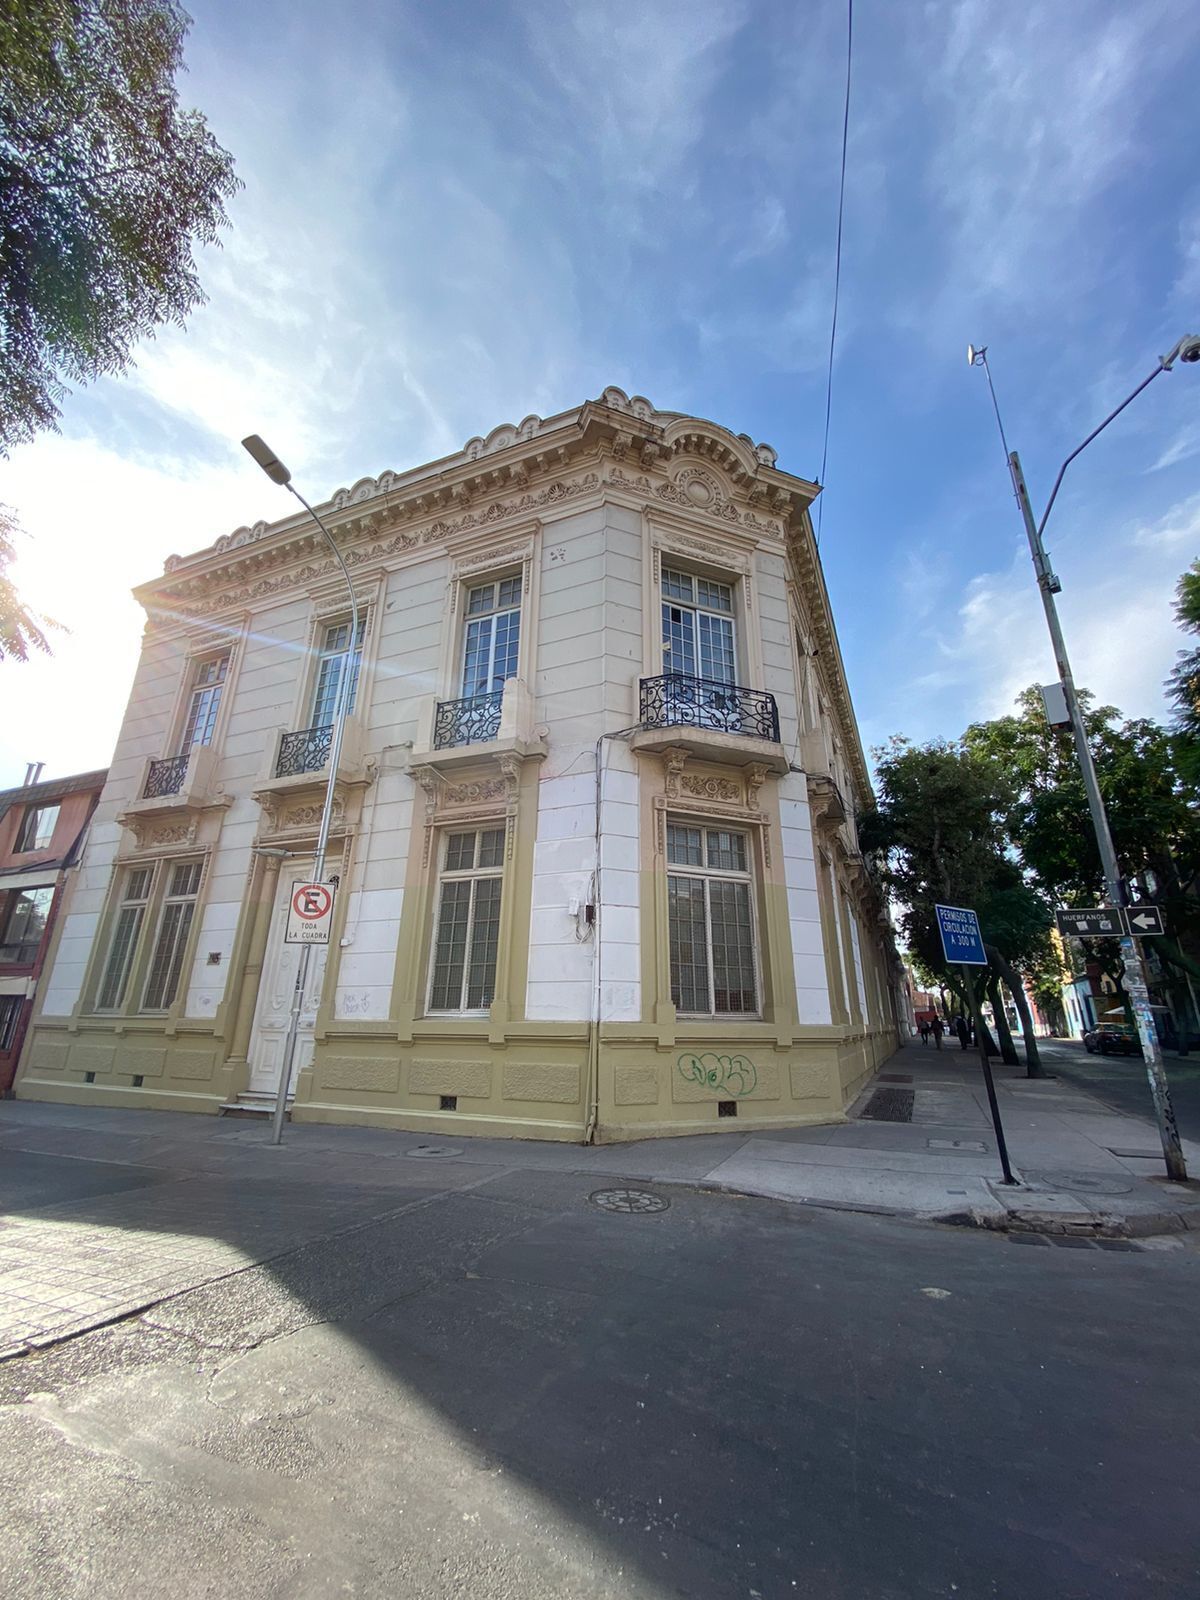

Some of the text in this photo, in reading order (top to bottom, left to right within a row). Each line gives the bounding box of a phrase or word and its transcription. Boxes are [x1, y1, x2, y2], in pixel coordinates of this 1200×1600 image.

[940, 909, 976, 923] PERMISOS DE
[951, 935, 956, 944] A
[957, 935, 969, 946] 300
